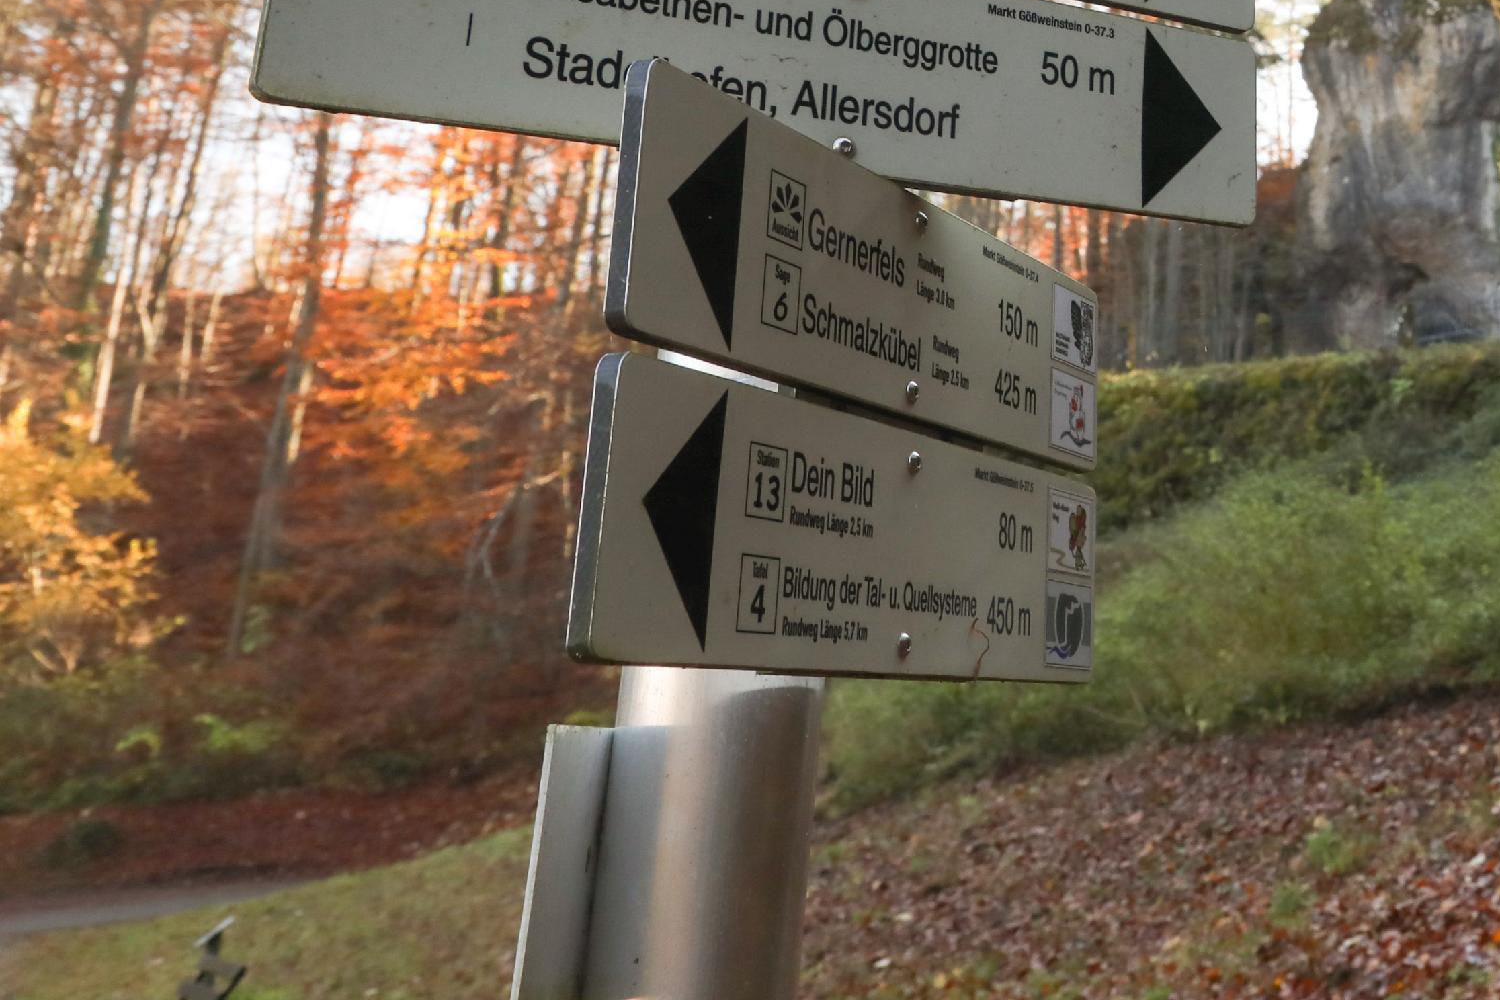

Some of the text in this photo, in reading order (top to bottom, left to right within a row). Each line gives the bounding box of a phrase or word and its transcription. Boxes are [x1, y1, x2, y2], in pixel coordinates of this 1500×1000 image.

[755, 8, 813, 42] und
[823, 8, 999, 75] Ölberggrotte
[988, 3, 1115, 39] Markt Gößweinstein 0-37.3
[1041, 51, 1115, 95] 50 m
[790, 79, 961, 139] Allersdorf
[808, 207, 905, 288] Gernerfels
[773, 291, 788, 322] 6
[998, 298, 1023, 340] 150
[1026, 319, 1039, 348] m
[802, 293, 921, 373] Schmalzkübel
[994, 368, 1020, 410] 425
[1025, 386, 1037, 415] m
[753, 472, 780, 511] 13
[792, 451, 874, 508] Dein Bild
[862, 518, 874, 538] km
[999, 512, 1033, 554] 80 m
[750, 584, 766, 623] 4
[783, 566, 977, 621] Bildung der Tal- u. Quellsysteme
[856, 621, 868, 641] km
[986, 595, 1031, 637] 450 m
